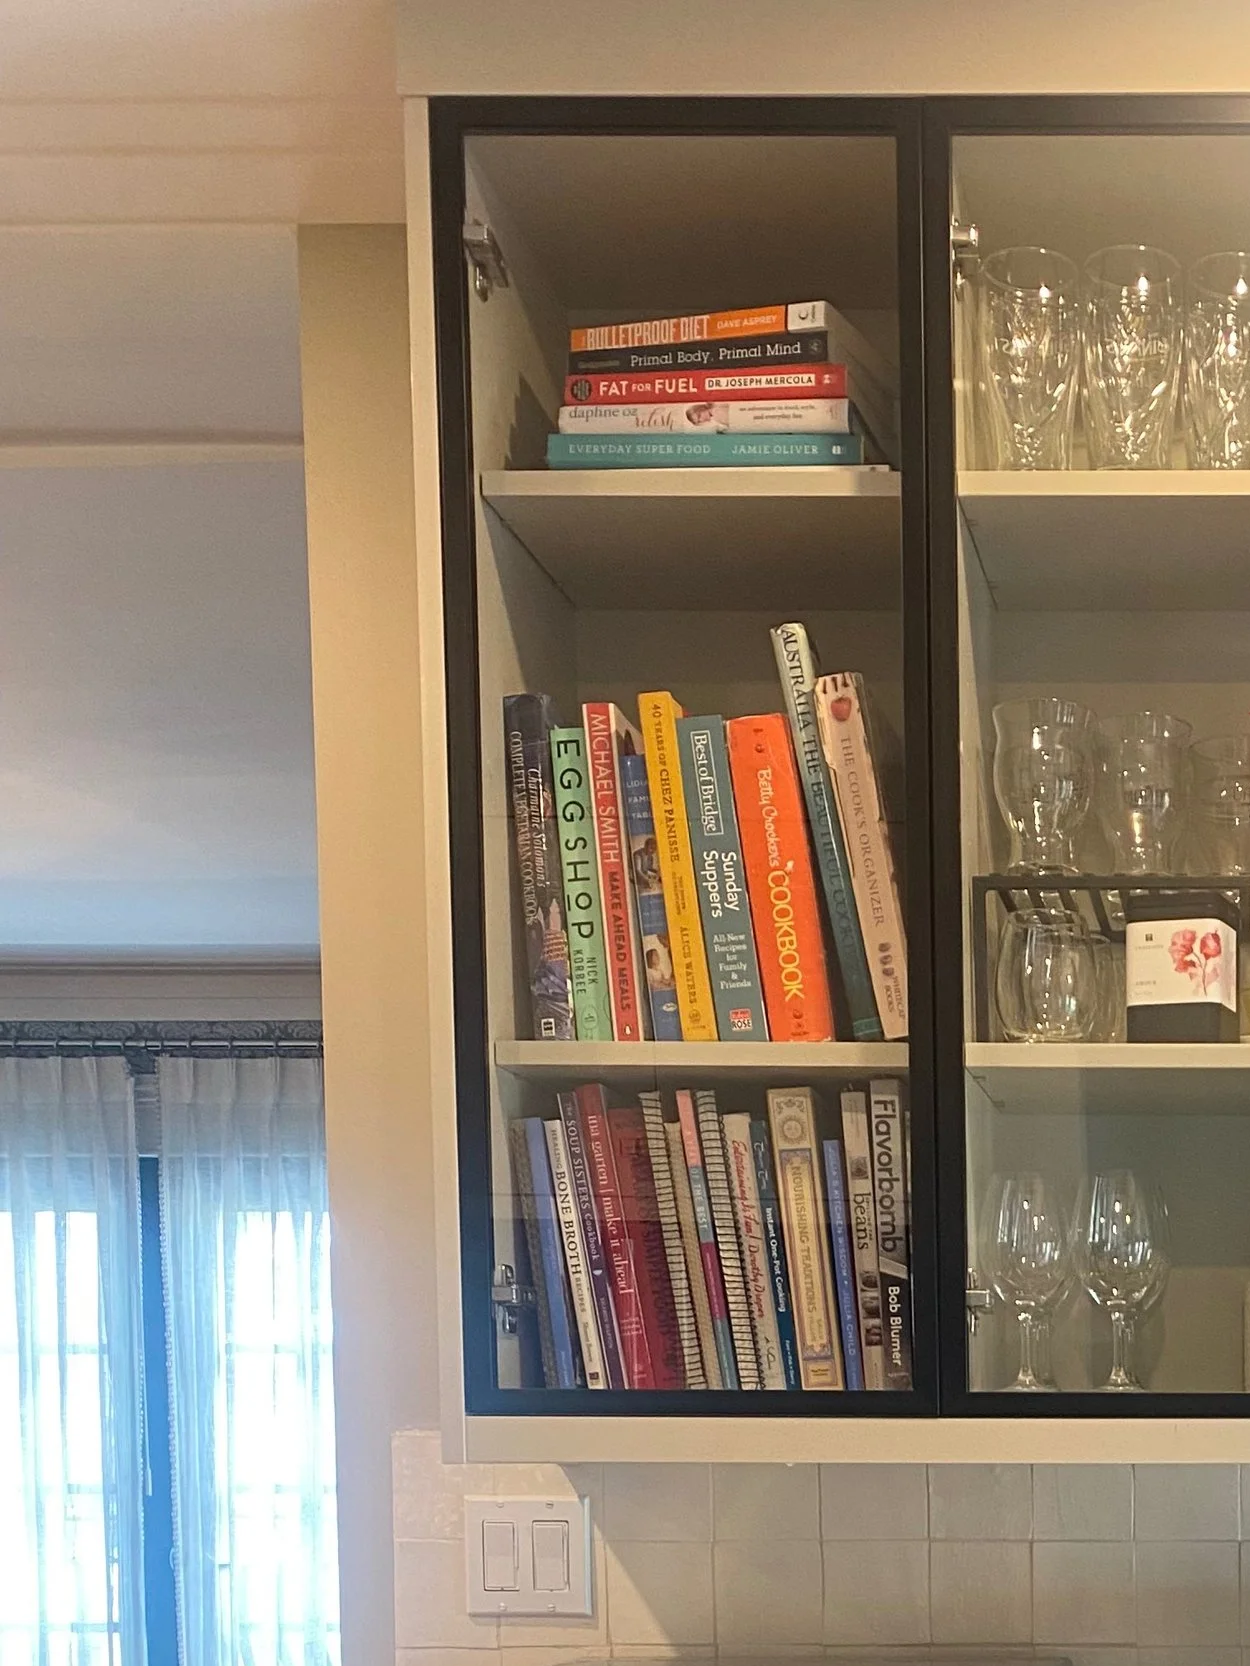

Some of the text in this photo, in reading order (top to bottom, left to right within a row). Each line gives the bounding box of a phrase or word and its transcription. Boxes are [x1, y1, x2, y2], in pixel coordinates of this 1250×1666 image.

[586, 314, 710, 350] BULLETPROOF DIET
[717, 314, 778, 330] DAVE ASPREY
[630, 352, 673, 367] Primal
[719, 345, 762, 360] Primal
[766, 341, 801, 357] Mind
[600, 378, 698, 396] FAT FOR FUEL
[725, 377, 762, 387] JOSEPH
[765, 375, 813, 385] MERCOLA
[569, 406, 638, 422] daphne oz
[569, 444, 711, 454] EVERYDAY SUPER FOOD
[731, 445, 818, 455] JAMIE OLIVER
[781, 627, 813, 730] AUSTRALIA
[652, 703, 663, 718] 40
[803, 735, 822, 776] THE
[528, 768, 543, 829] Charmaine
[590, 713, 621, 862] MICHAEL SMITH
[660, 769, 673, 805] CHEZ
[694, 734, 708, 765] Best
[701, 783, 719, 832] Bridge
[510, 731, 526, 791] COMPLETE
[520, 861, 538, 925] COOKBOOK
[664, 808, 680, 862] PANISSE
[811, 780, 841, 886] BEAUTIFUL
[841, 737, 885, 928] THE COOK'S ORGANIZER
[701, 850, 722, 918] Suppers
[721, 851, 743, 911] Sunday
[757, 767, 805, 1003] Betty Crocker's COOKBOOK
[608, 871, 631, 1010] MAKE AHEAD MEALS
[714, 943, 747, 954] Recipes
[573, 949, 586, 994] KORBEE
[586, 956, 599, 984] NICK
[680, 927, 697, 1004] ALICE WATERS
[719, 963, 748, 974] Family
[720, 979, 752, 990] Friends
[731, 1019, 752, 1029] ROSE
[566, 1120, 581, 1153] SOUP
[573, 1158, 590, 1209] SISTERS
[592, 1141, 608, 1185] garten
[873, 1099, 904, 1252] Flavorbomb
[551, 1129, 587, 1313] HEALING BONE BROTH RECIPES
[583, 1213, 600, 1260] Cookbook
[603, 1197, 621, 1235] make
[697, 1206, 708, 1229] BEST
[853, 1192, 871, 1250] beans
[610, 1238, 625, 1248] it
[765, 1207, 786, 1312] Instant One-Pot Cooking
[790, 1165, 810, 1243] NOURISHING
[801, 1247, 817, 1313] TRADITIONS
[613, 1253, 634, 1294] ahead
[749, 1244, 765, 1284] Dorothy
[754, 1285, 766, 1318] Draper
[888, 1285, 901, 1313] Bob
[890, 1316, 902, 1366] Blumer
